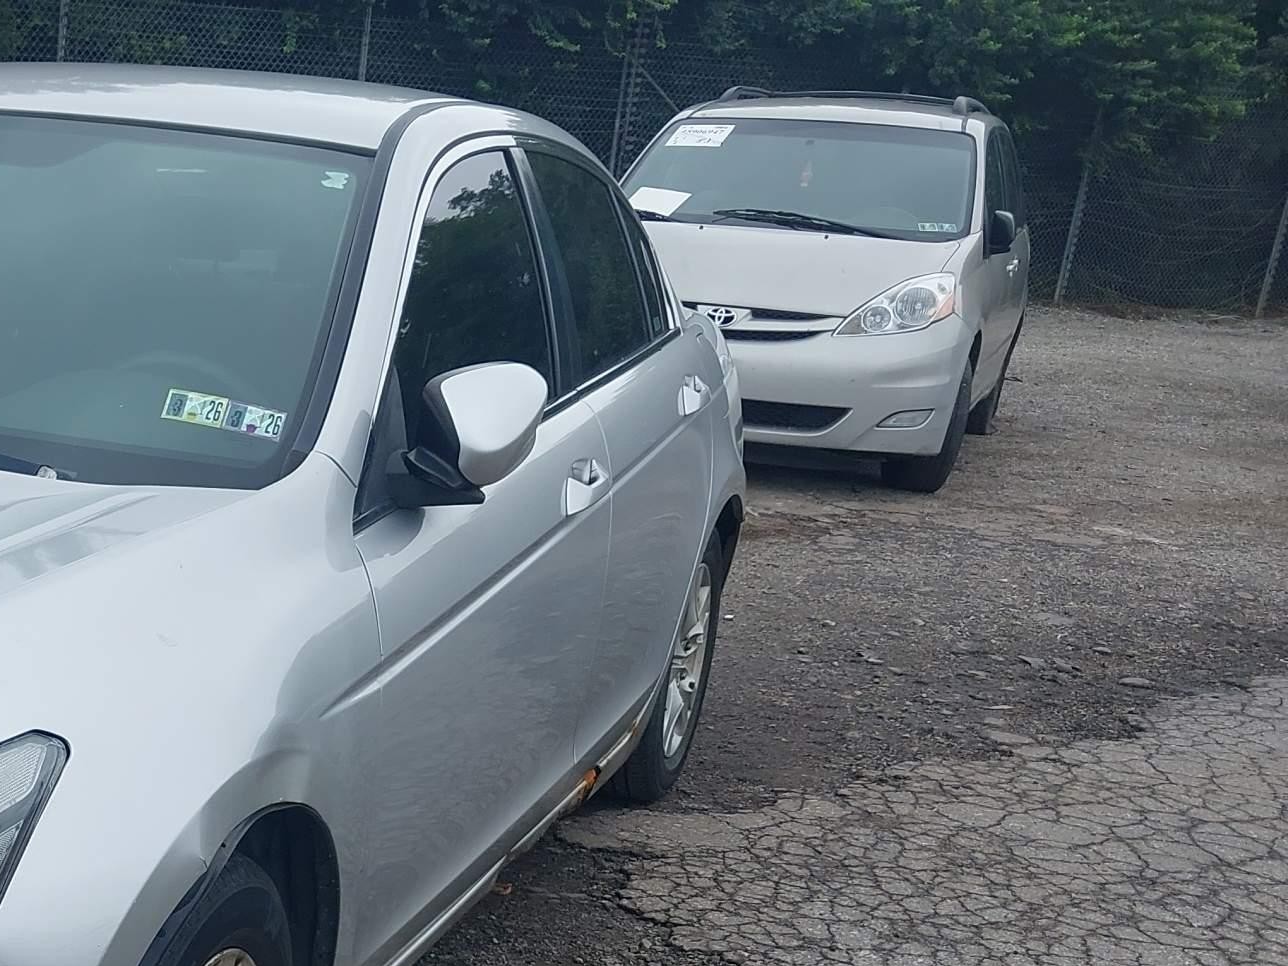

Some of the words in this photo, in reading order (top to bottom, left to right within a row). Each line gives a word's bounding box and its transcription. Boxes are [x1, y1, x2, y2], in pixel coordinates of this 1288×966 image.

[172, 398, 183, 412] 3
[205, 400, 224, 422] 26
[230, 409, 243, 428] 3
[264, 413, 283, 436] 26
